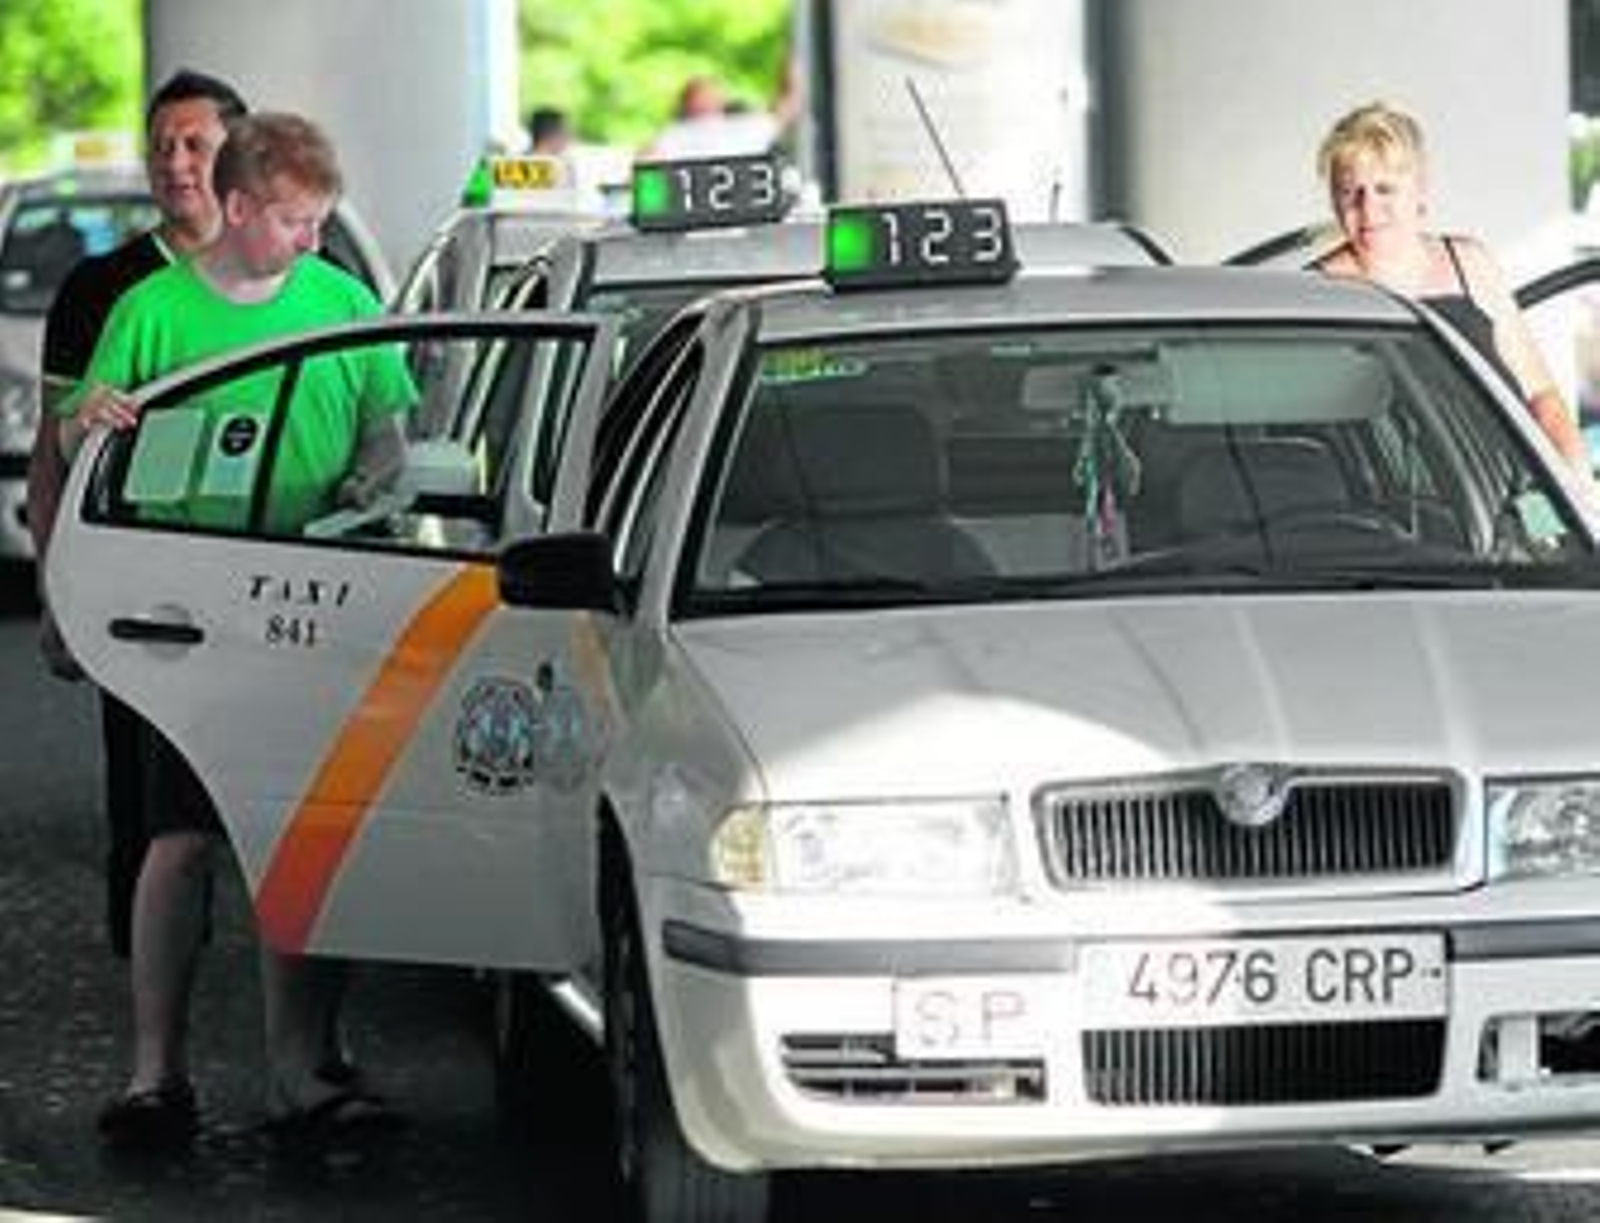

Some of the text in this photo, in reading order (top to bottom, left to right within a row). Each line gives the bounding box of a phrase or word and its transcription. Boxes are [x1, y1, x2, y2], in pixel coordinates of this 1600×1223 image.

[675, 162, 774, 211] 123
[882, 207, 1003, 266] 123
[1126, 948, 1415, 1006] 4976 CRP
